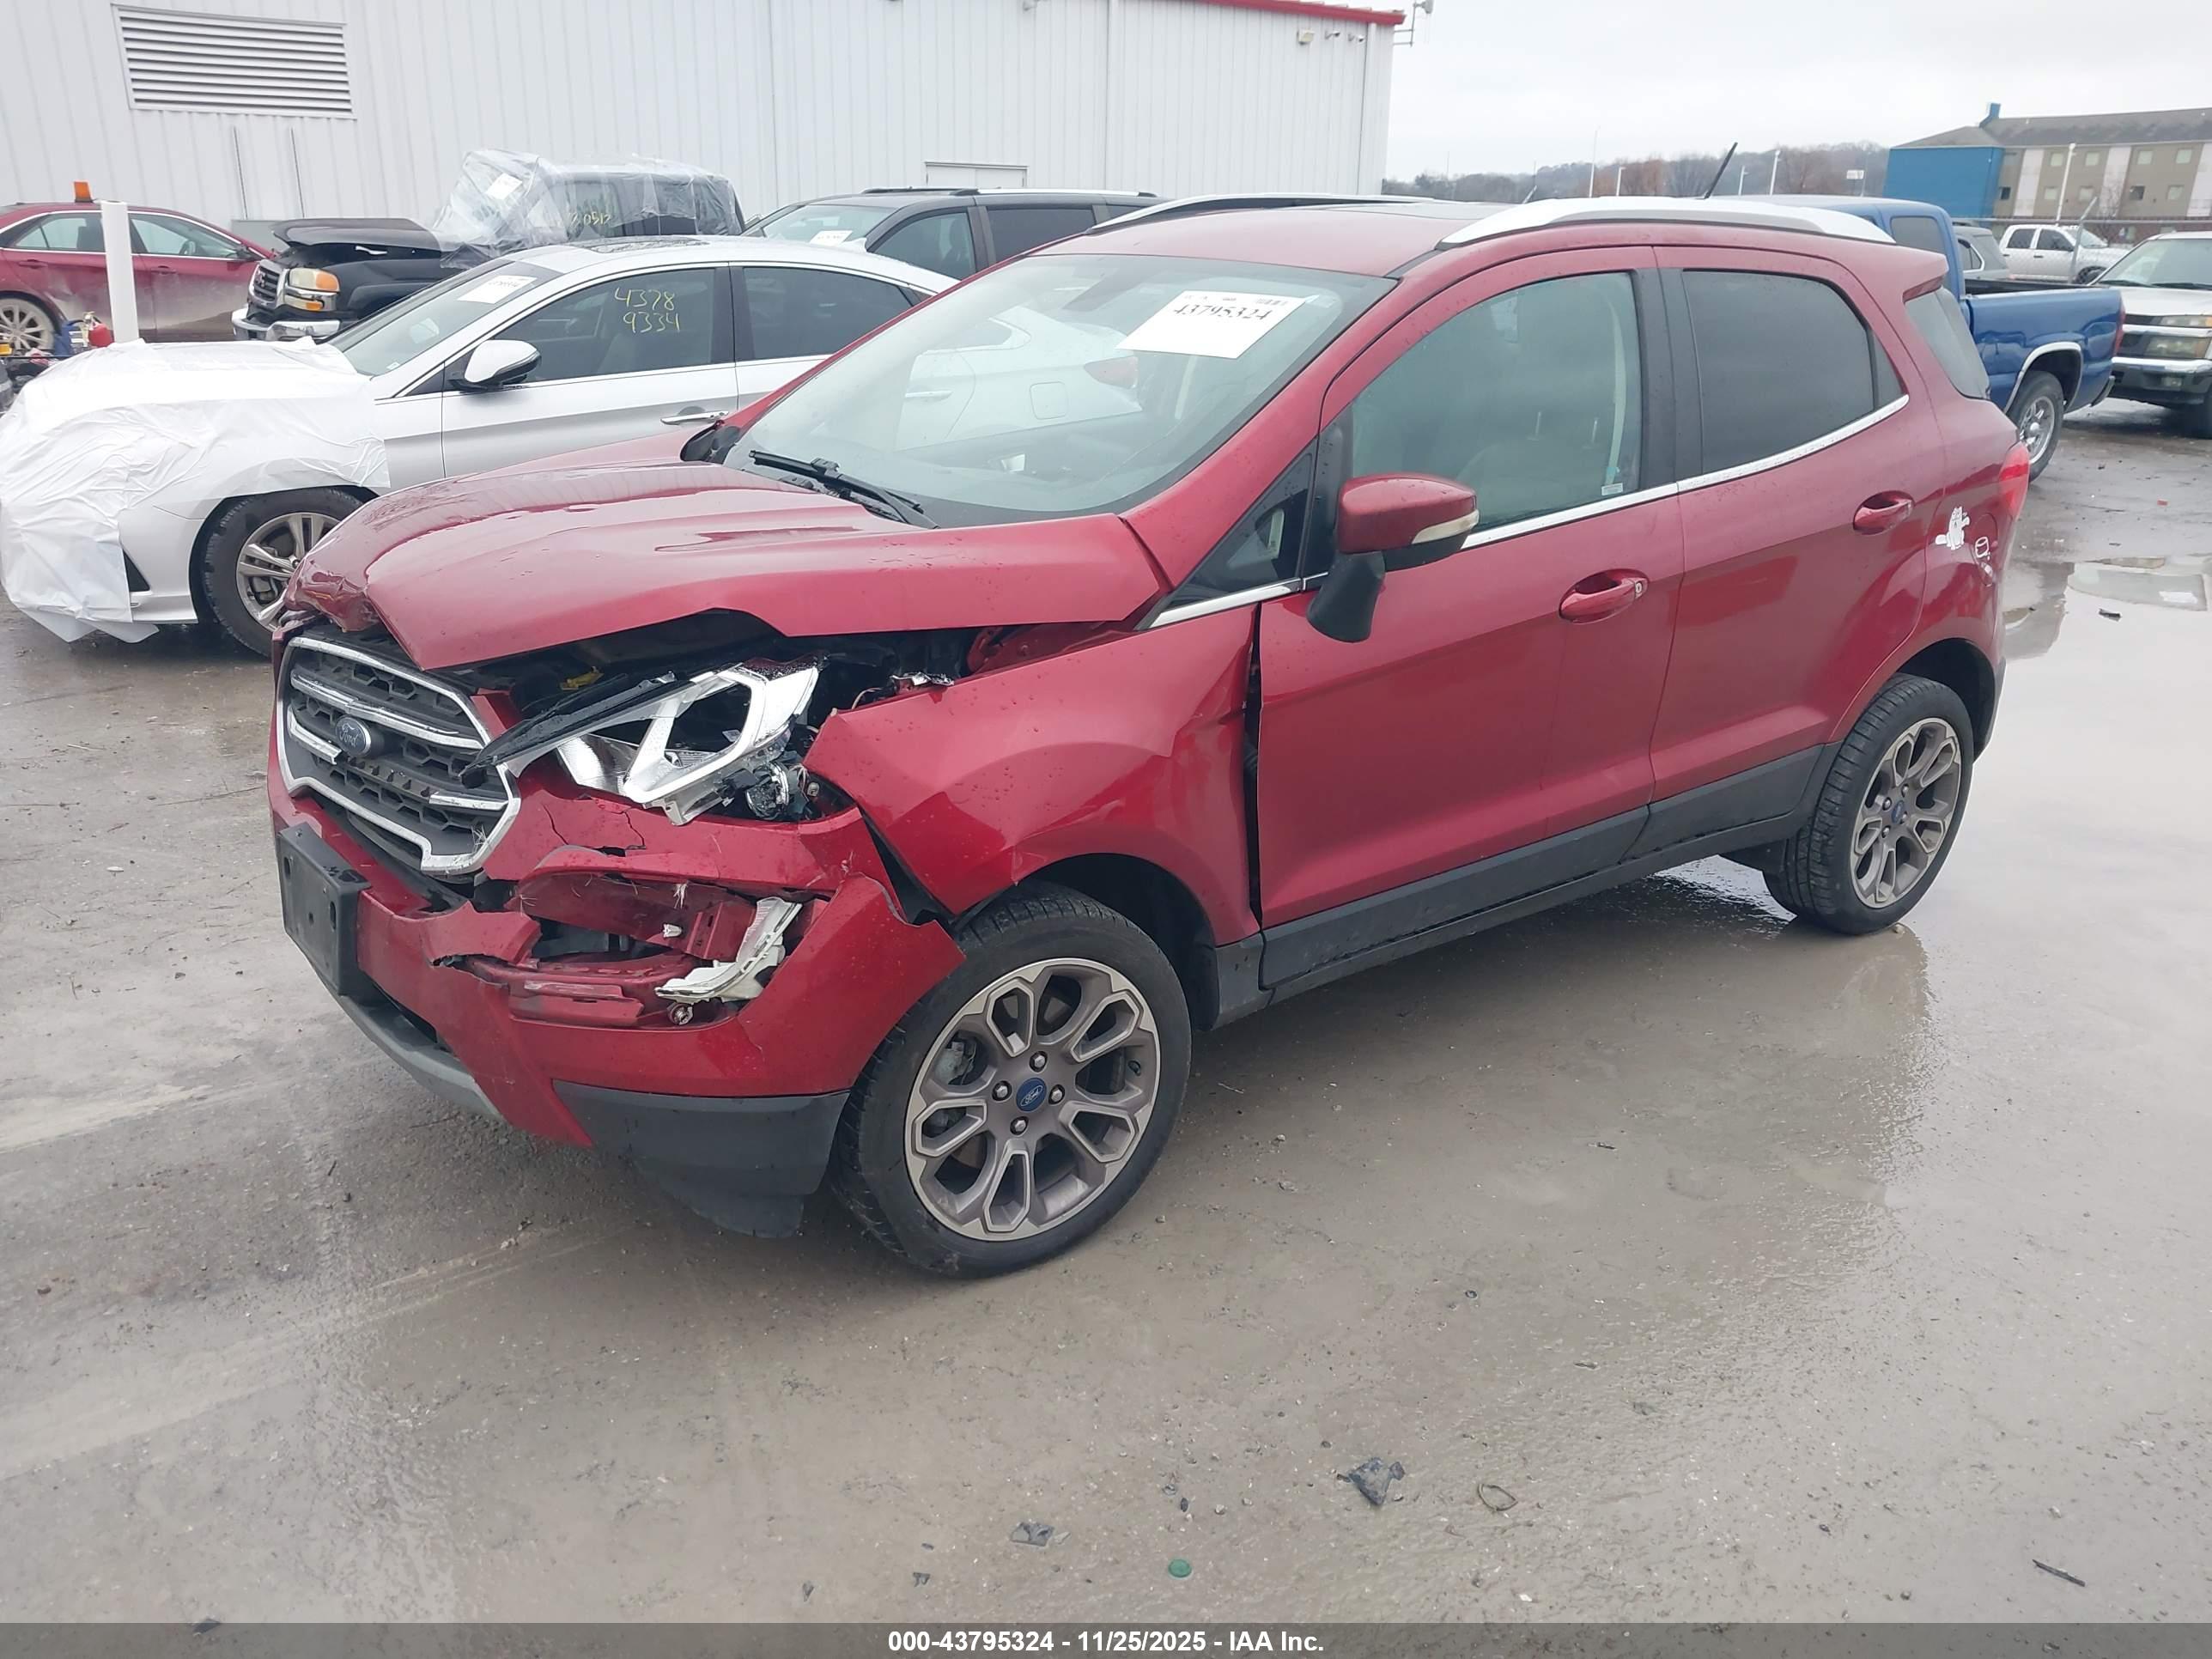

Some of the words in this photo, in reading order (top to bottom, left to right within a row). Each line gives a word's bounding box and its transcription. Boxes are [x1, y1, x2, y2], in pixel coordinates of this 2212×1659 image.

[614, 287, 675, 311] 4378
[623, 311, 681, 333] 9334
[1173, 303, 1273, 320] 43795324
[339, 722, 359, 748] Ford
